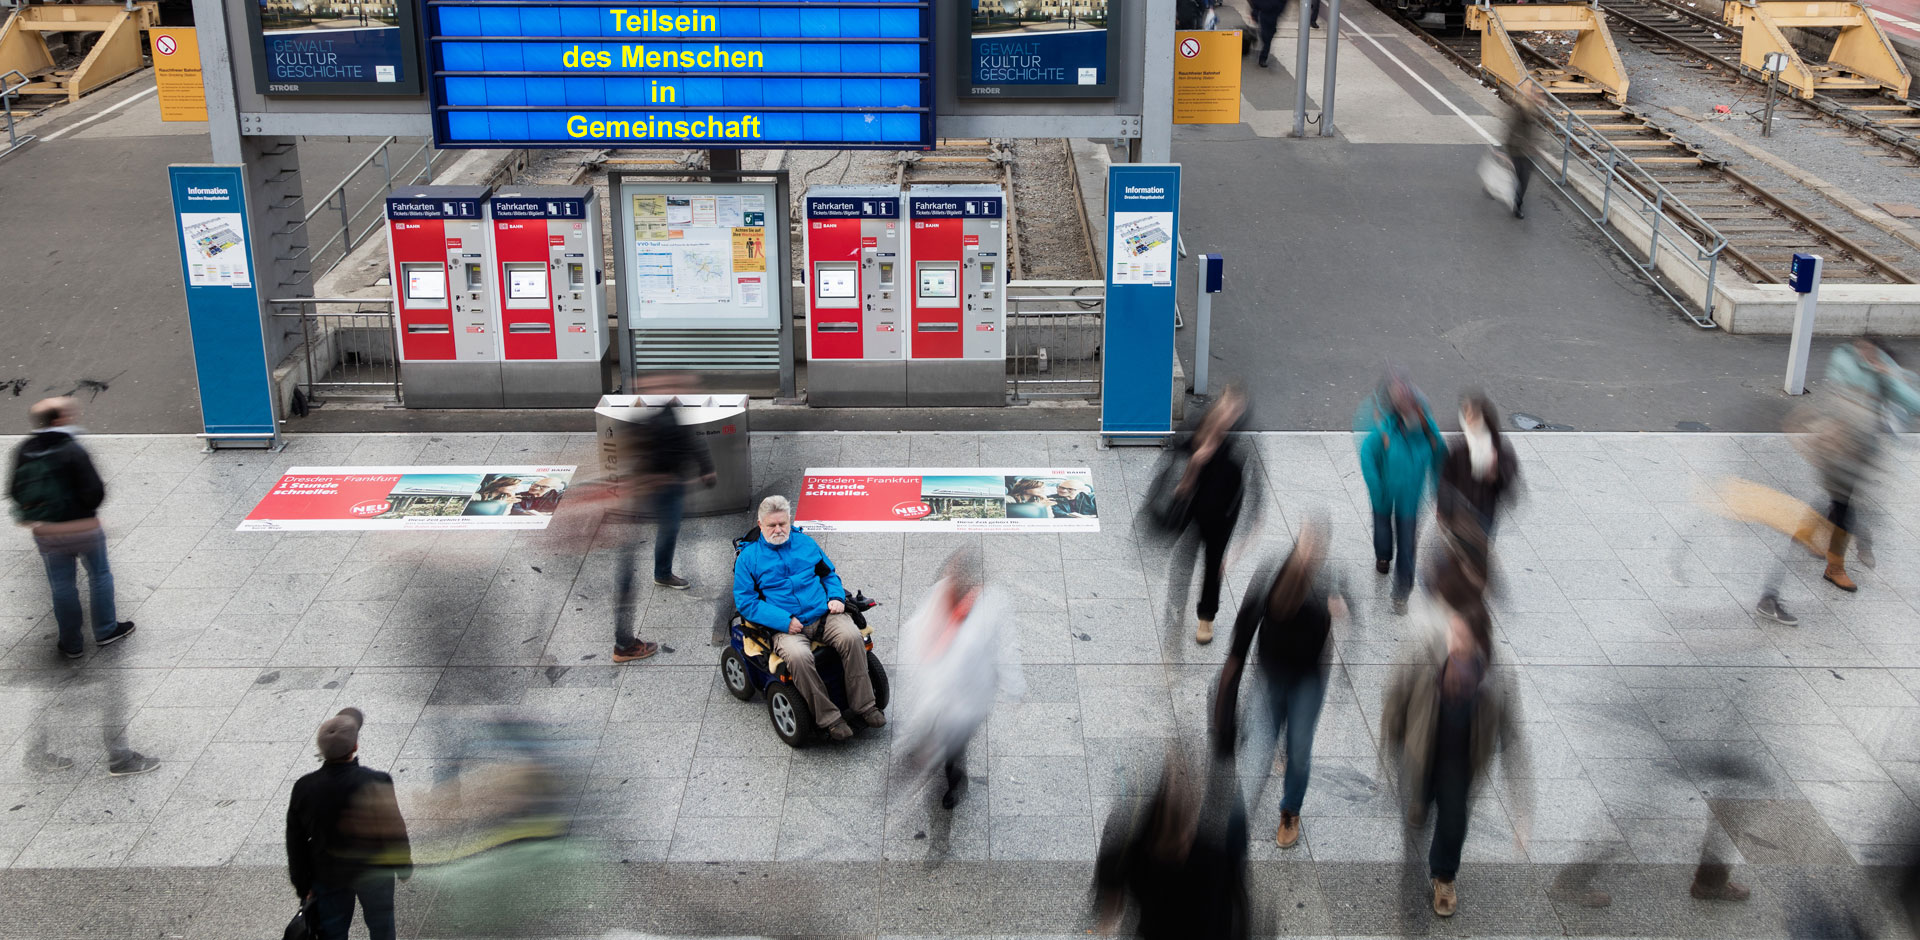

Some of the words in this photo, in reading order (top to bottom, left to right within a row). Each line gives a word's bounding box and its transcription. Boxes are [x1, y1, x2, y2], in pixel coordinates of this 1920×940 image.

[610, 10, 715, 31] Teilsein
[274, 40, 334, 52] GEWALT
[980, 42, 1040, 56] GEWALT
[276, 52, 338, 65] KULTUR
[563, 46, 611, 67] des
[623, 46, 762, 67] Menschen
[980, 56, 1042, 68] KULTUR
[277, 66, 363, 78] GESCHICHTE
[980, 68, 1064, 80] GESCHICHTE
[652, 81, 674, 102] in
[567, 116, 760, 137] Gemeinschaft
[352, 503, 389, 513] NEU
[894, 505, 929, 515] NEU
